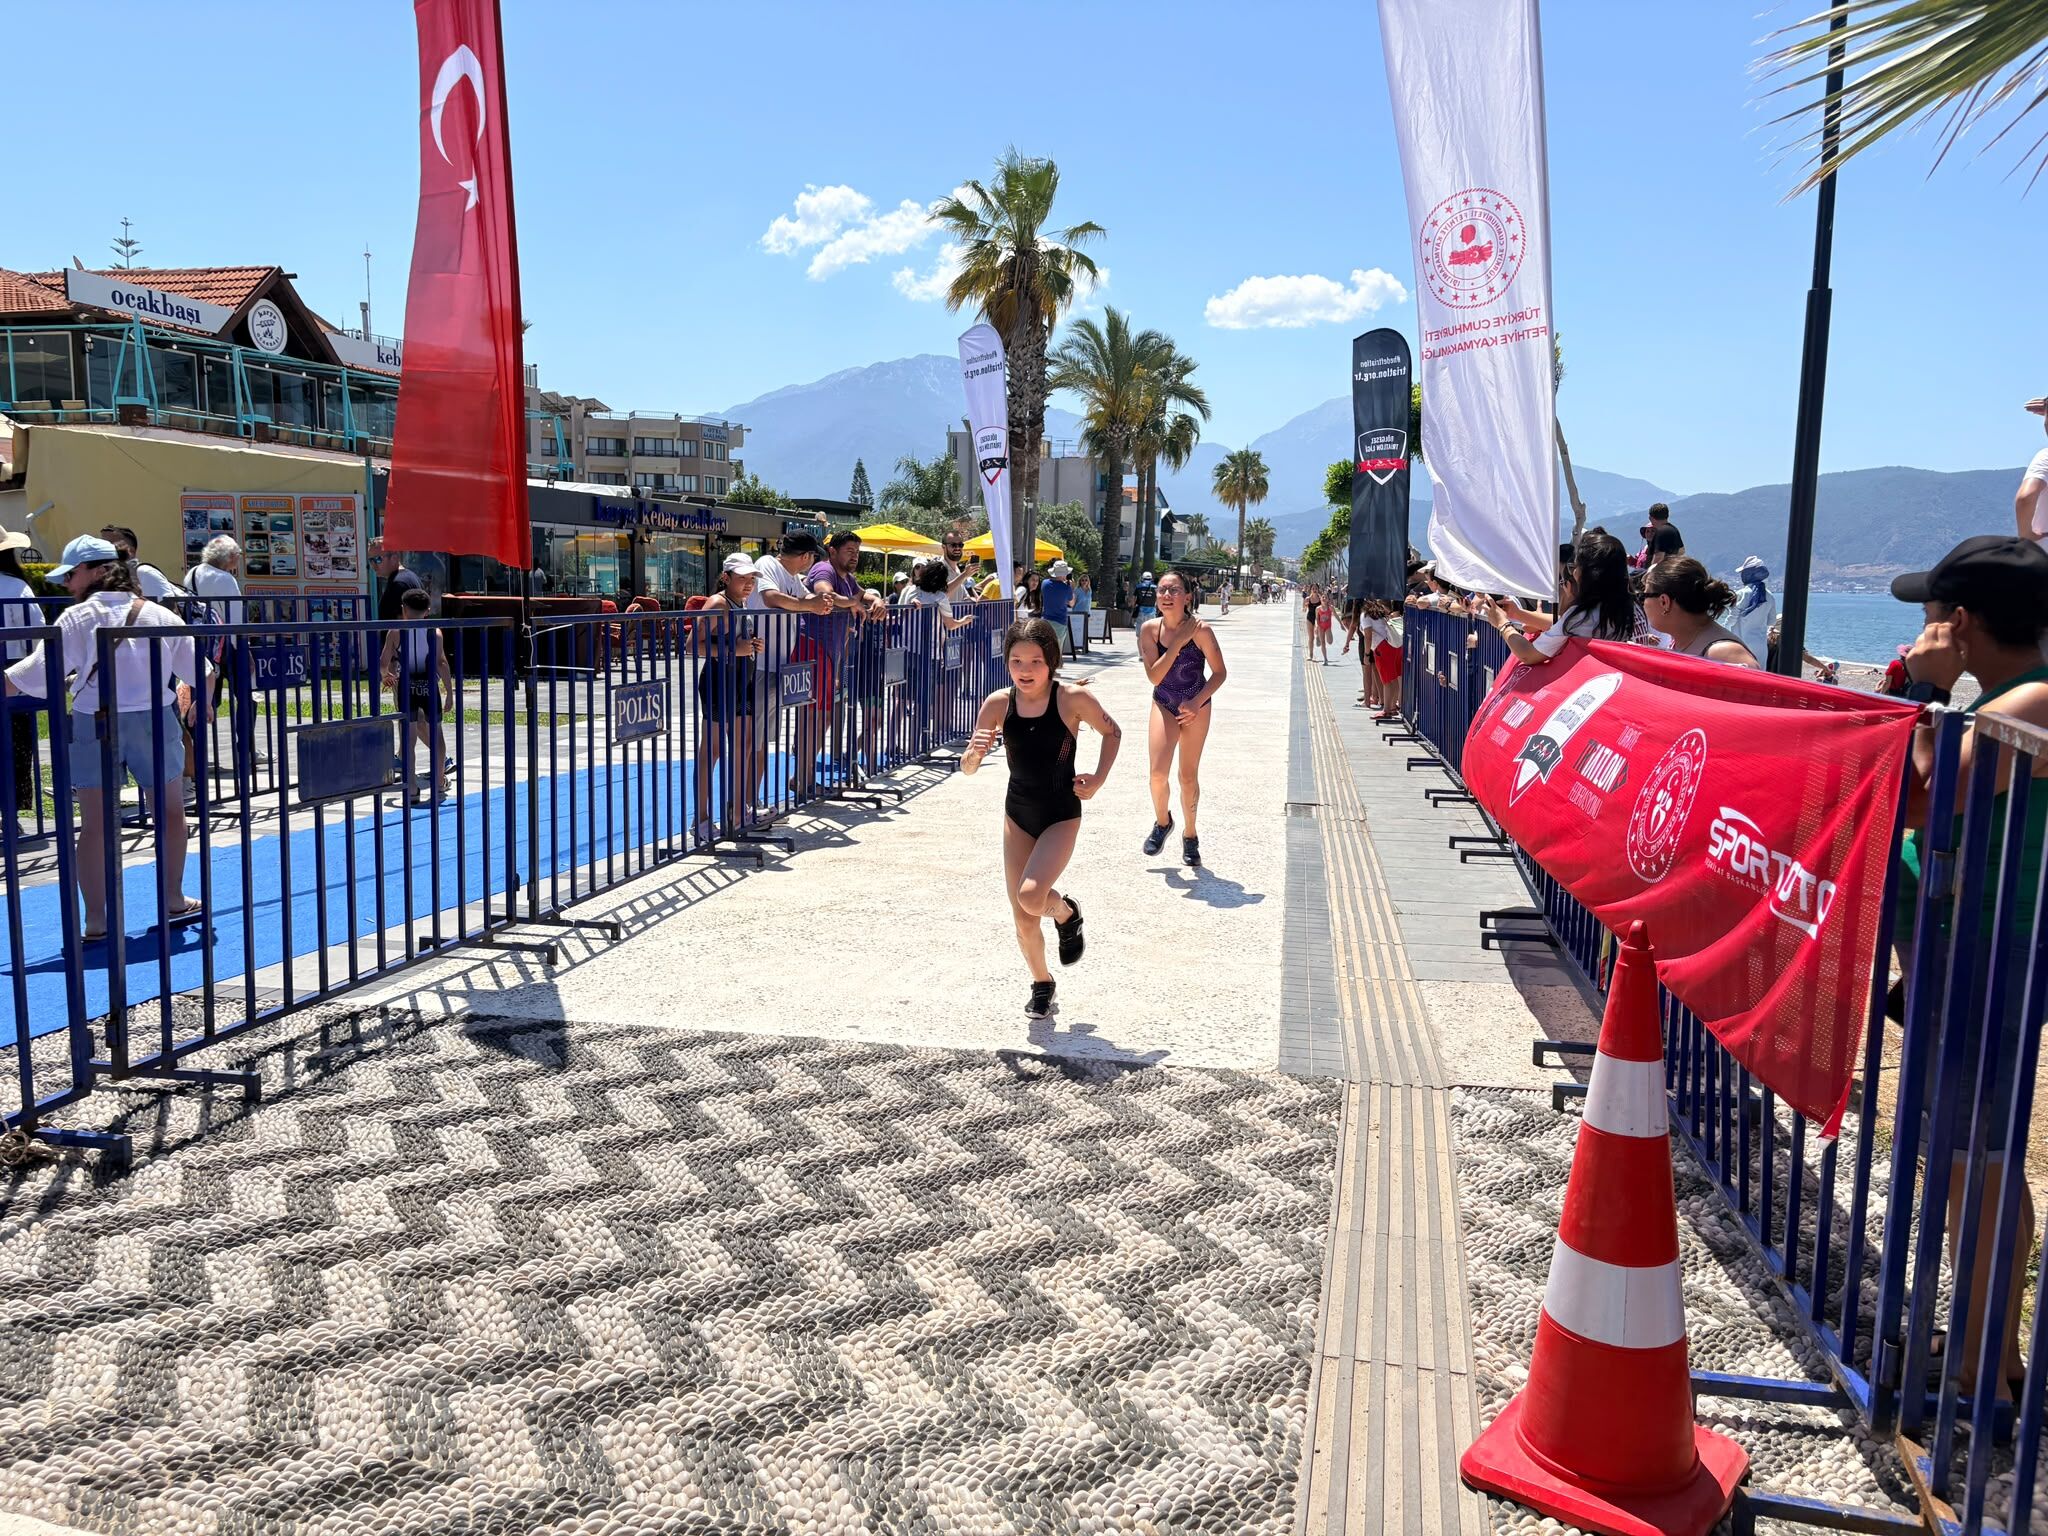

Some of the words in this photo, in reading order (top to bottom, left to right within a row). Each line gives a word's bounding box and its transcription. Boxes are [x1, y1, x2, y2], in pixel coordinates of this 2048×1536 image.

[111, 289, 202, 325] ocakbaşı
[377, 345, 402, 367] keb
[784, 669, 811, 696] POLİS
[617, 692, 661, 727] POLİS
